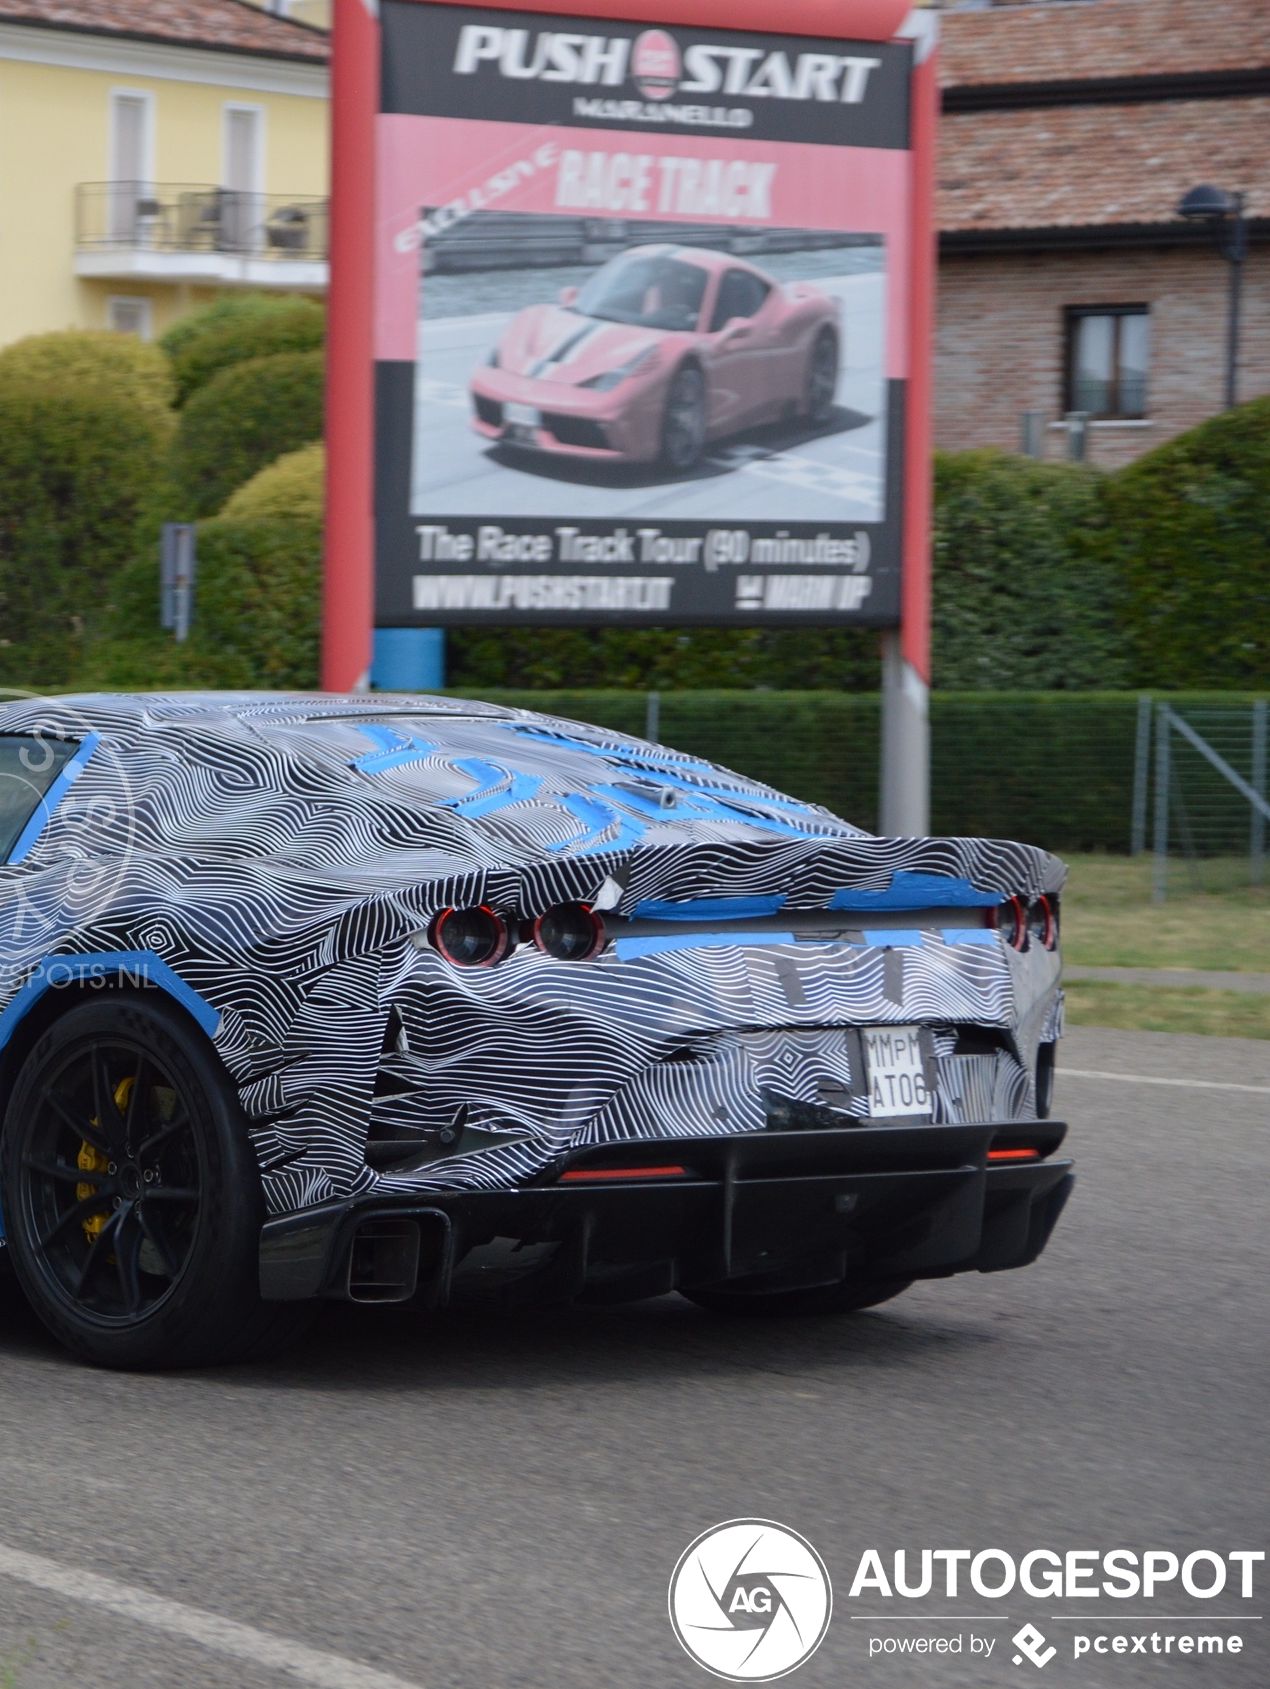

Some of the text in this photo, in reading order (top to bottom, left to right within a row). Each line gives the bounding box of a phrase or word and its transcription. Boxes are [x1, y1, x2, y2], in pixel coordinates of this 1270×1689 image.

[453, 24, 630, 86] PUSH
[679, 43, 881, 104] START
[572, 97, 754, 129] MARANELLO
[555, 148, 778, 219] RACE TRACK
[415, 524, 872, 574] The Race Track Tour (90 minutes)
